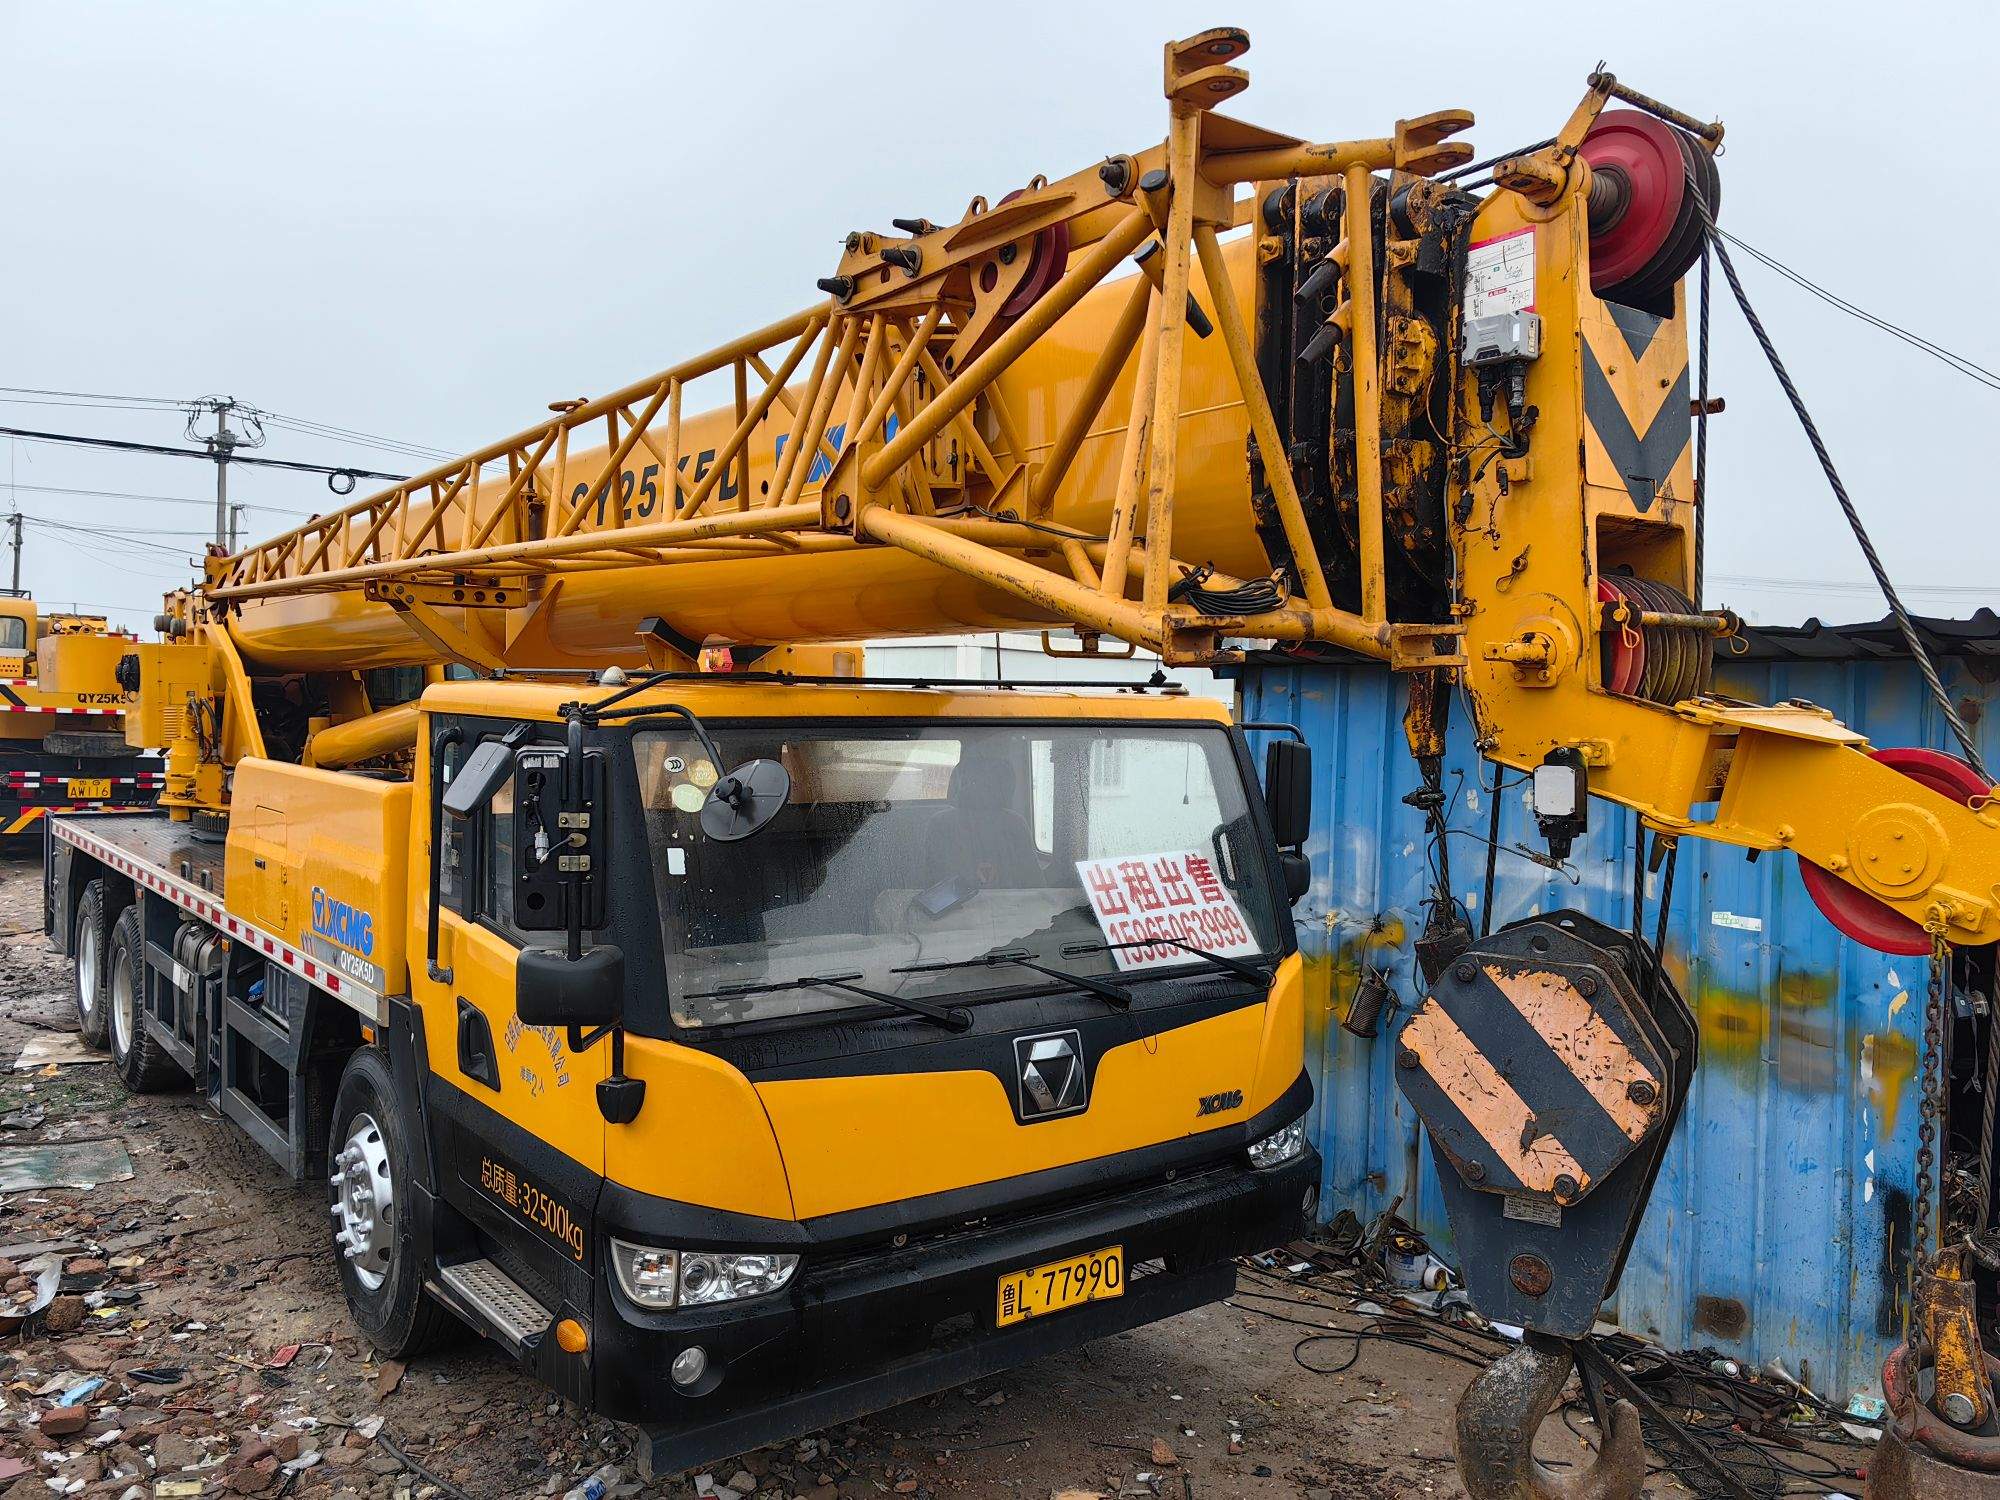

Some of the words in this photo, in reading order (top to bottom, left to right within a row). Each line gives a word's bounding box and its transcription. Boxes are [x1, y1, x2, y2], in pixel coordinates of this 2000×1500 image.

[1086, 852, 1226, 917] 出租出售
[324, 896, 375, 957] XCMG
[340, 950, 374, 984] QY25K5D
[1195, 1089, 1245, 1118] XCMG
